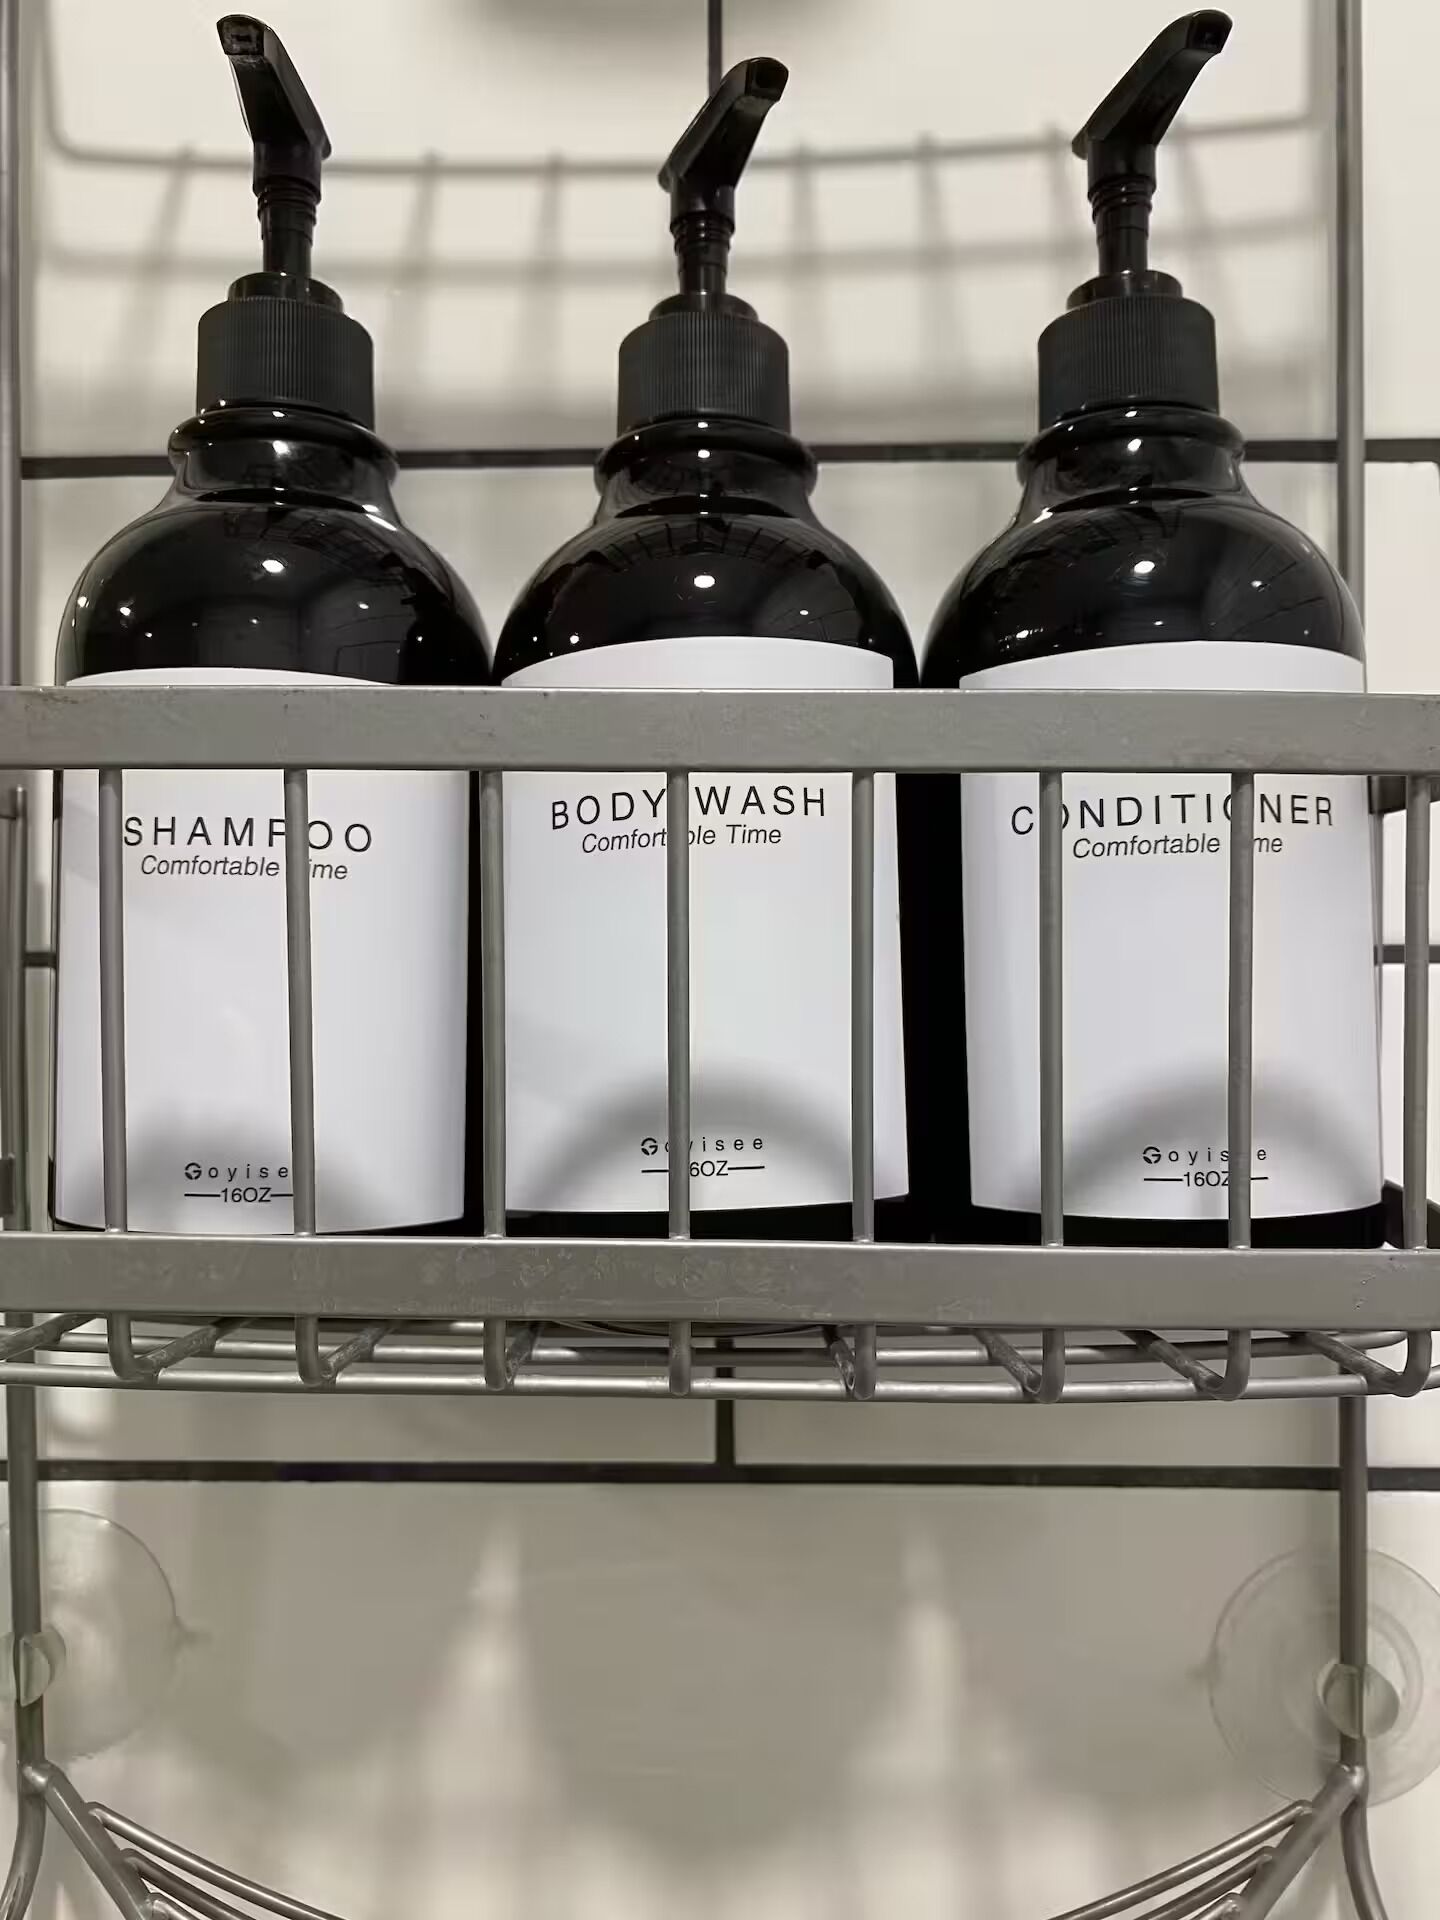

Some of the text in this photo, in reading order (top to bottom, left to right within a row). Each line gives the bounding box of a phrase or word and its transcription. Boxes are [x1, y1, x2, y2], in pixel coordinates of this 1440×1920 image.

[551, 785, 825, 830] BODY WASH
[123, 816, 372, 853] SHAMPOO
[580, 823, 782, 854] Comfortle Time
[1072, 832, 1283, 858] Comfortable me
[140, 854, 280, 877] Comfortable
[1141, 1145, 1267, 1166] Goyise
[184, 1162, 289, 1183] Goyise
[689, 1159, 729, 1178] 6OZ
[221, 1186, 273, 1203] 16OZ
